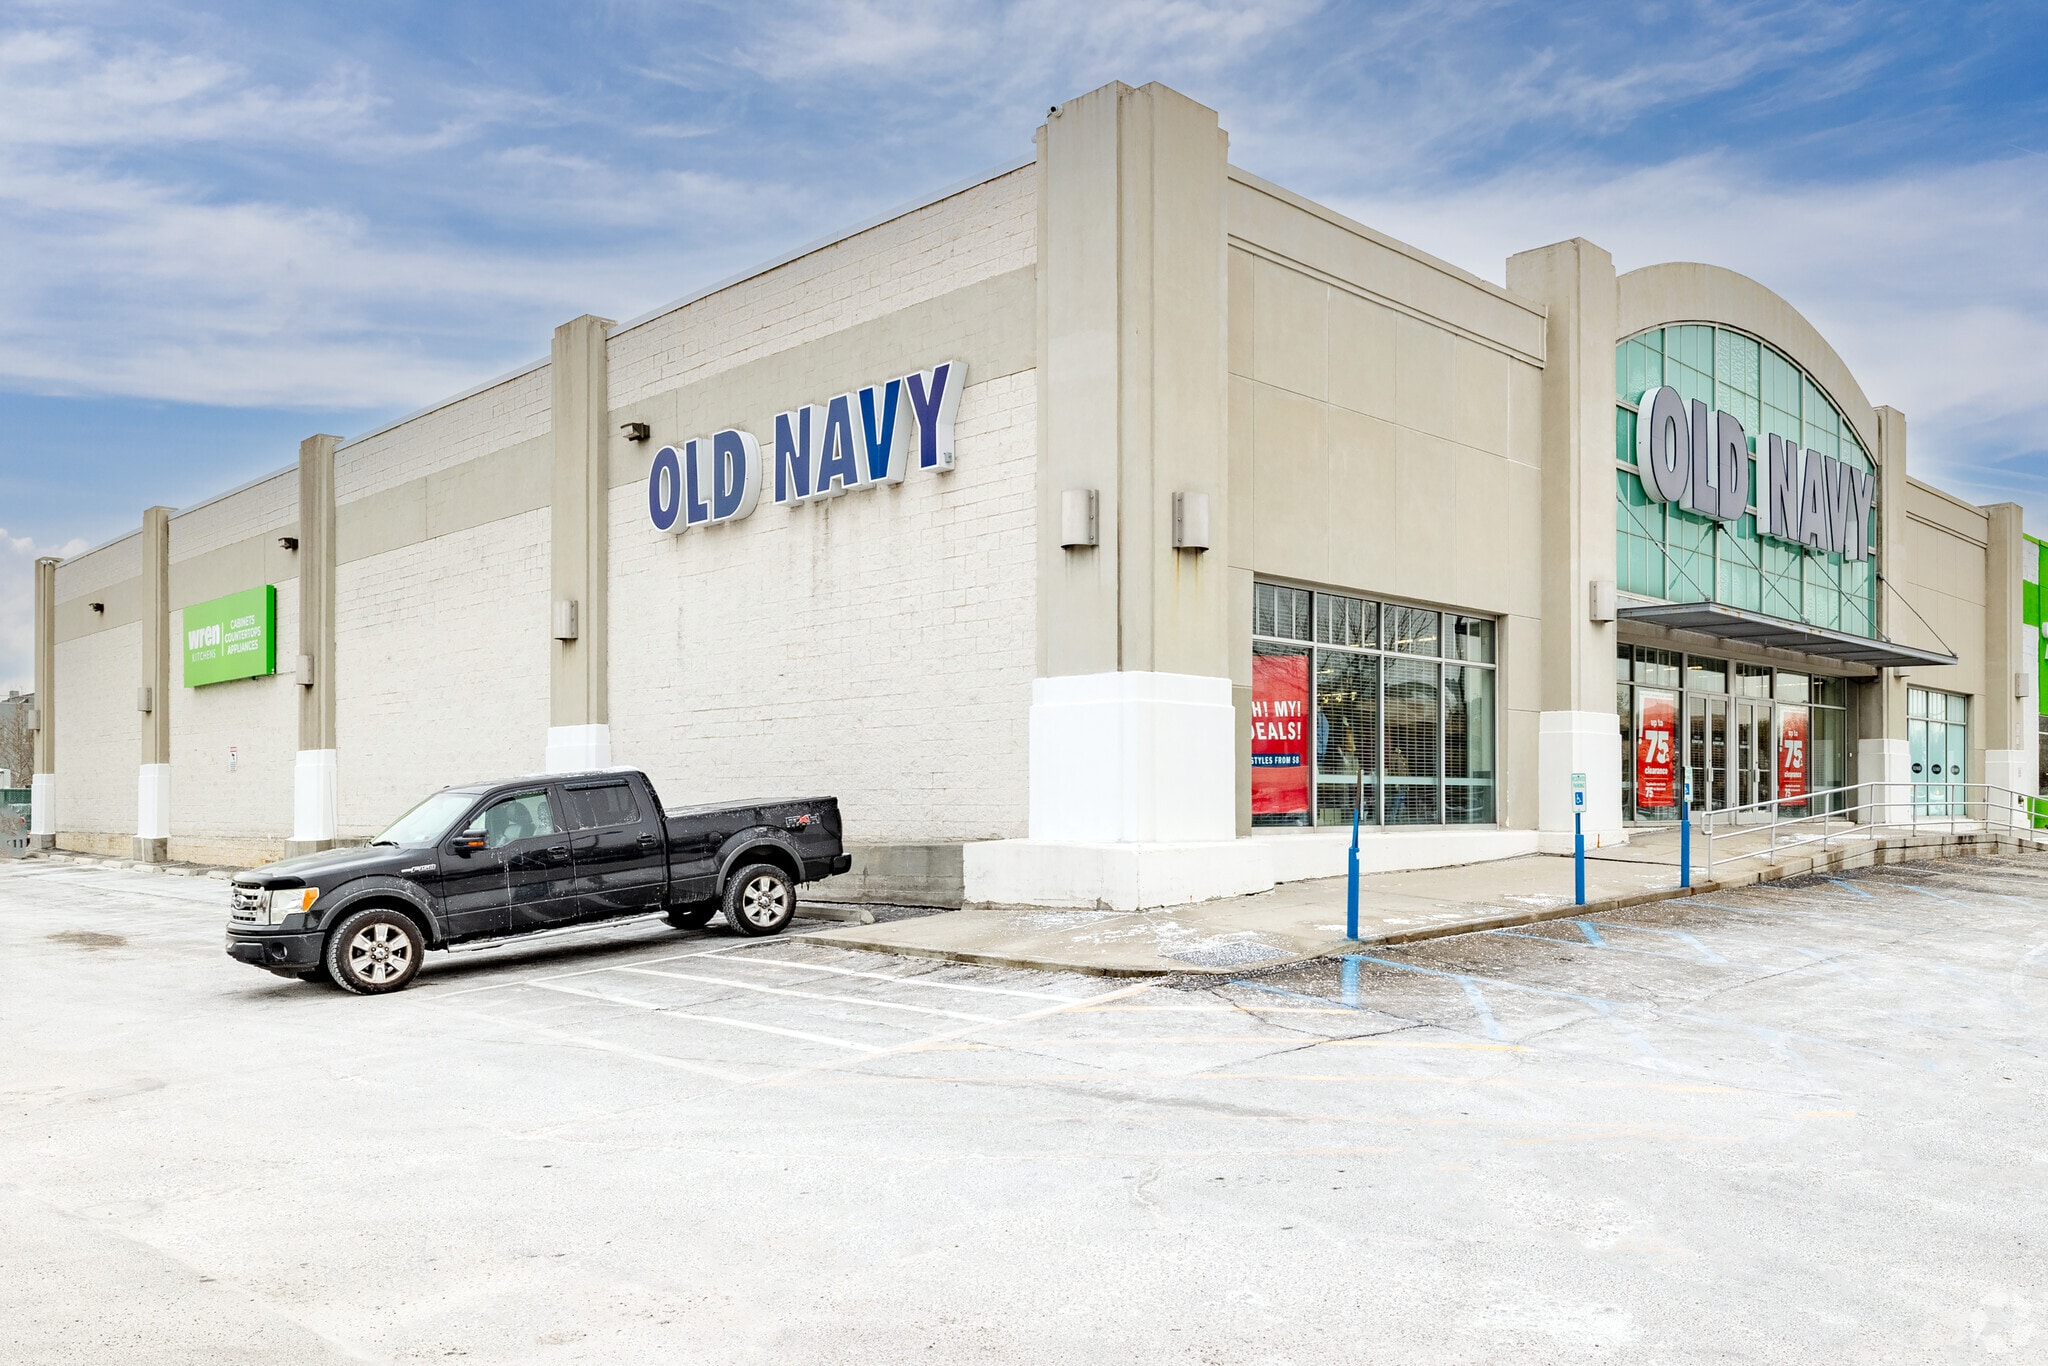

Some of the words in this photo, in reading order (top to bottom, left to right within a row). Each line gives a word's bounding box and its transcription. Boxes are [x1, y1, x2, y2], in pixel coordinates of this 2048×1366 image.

[648, 428, 752, 533] OLD
[773, 360, 958, 505] NAVY
[1646, 385, 1749, 521] OLD
[1765, 432, 1876, 562] NAVY
[230, 614, 255, 630] CABINETS
[188, 624, 220, 651] wren
[224, 626, 262, 643] COUNTERTOPS
[227, 639, 259, 655] APPLIANCES
[1251, 701, 1269, 717] H!
[1274, 700, 1301, 717] MY!
[1645, 730, 1669, 764] 75
[1784, 740, 1803, 769] 75
[1251, 756, 1273, 765] STYLES
[1274, 756, 1291, 765] FROM
[1644, 766, 1669, 775] clearance
